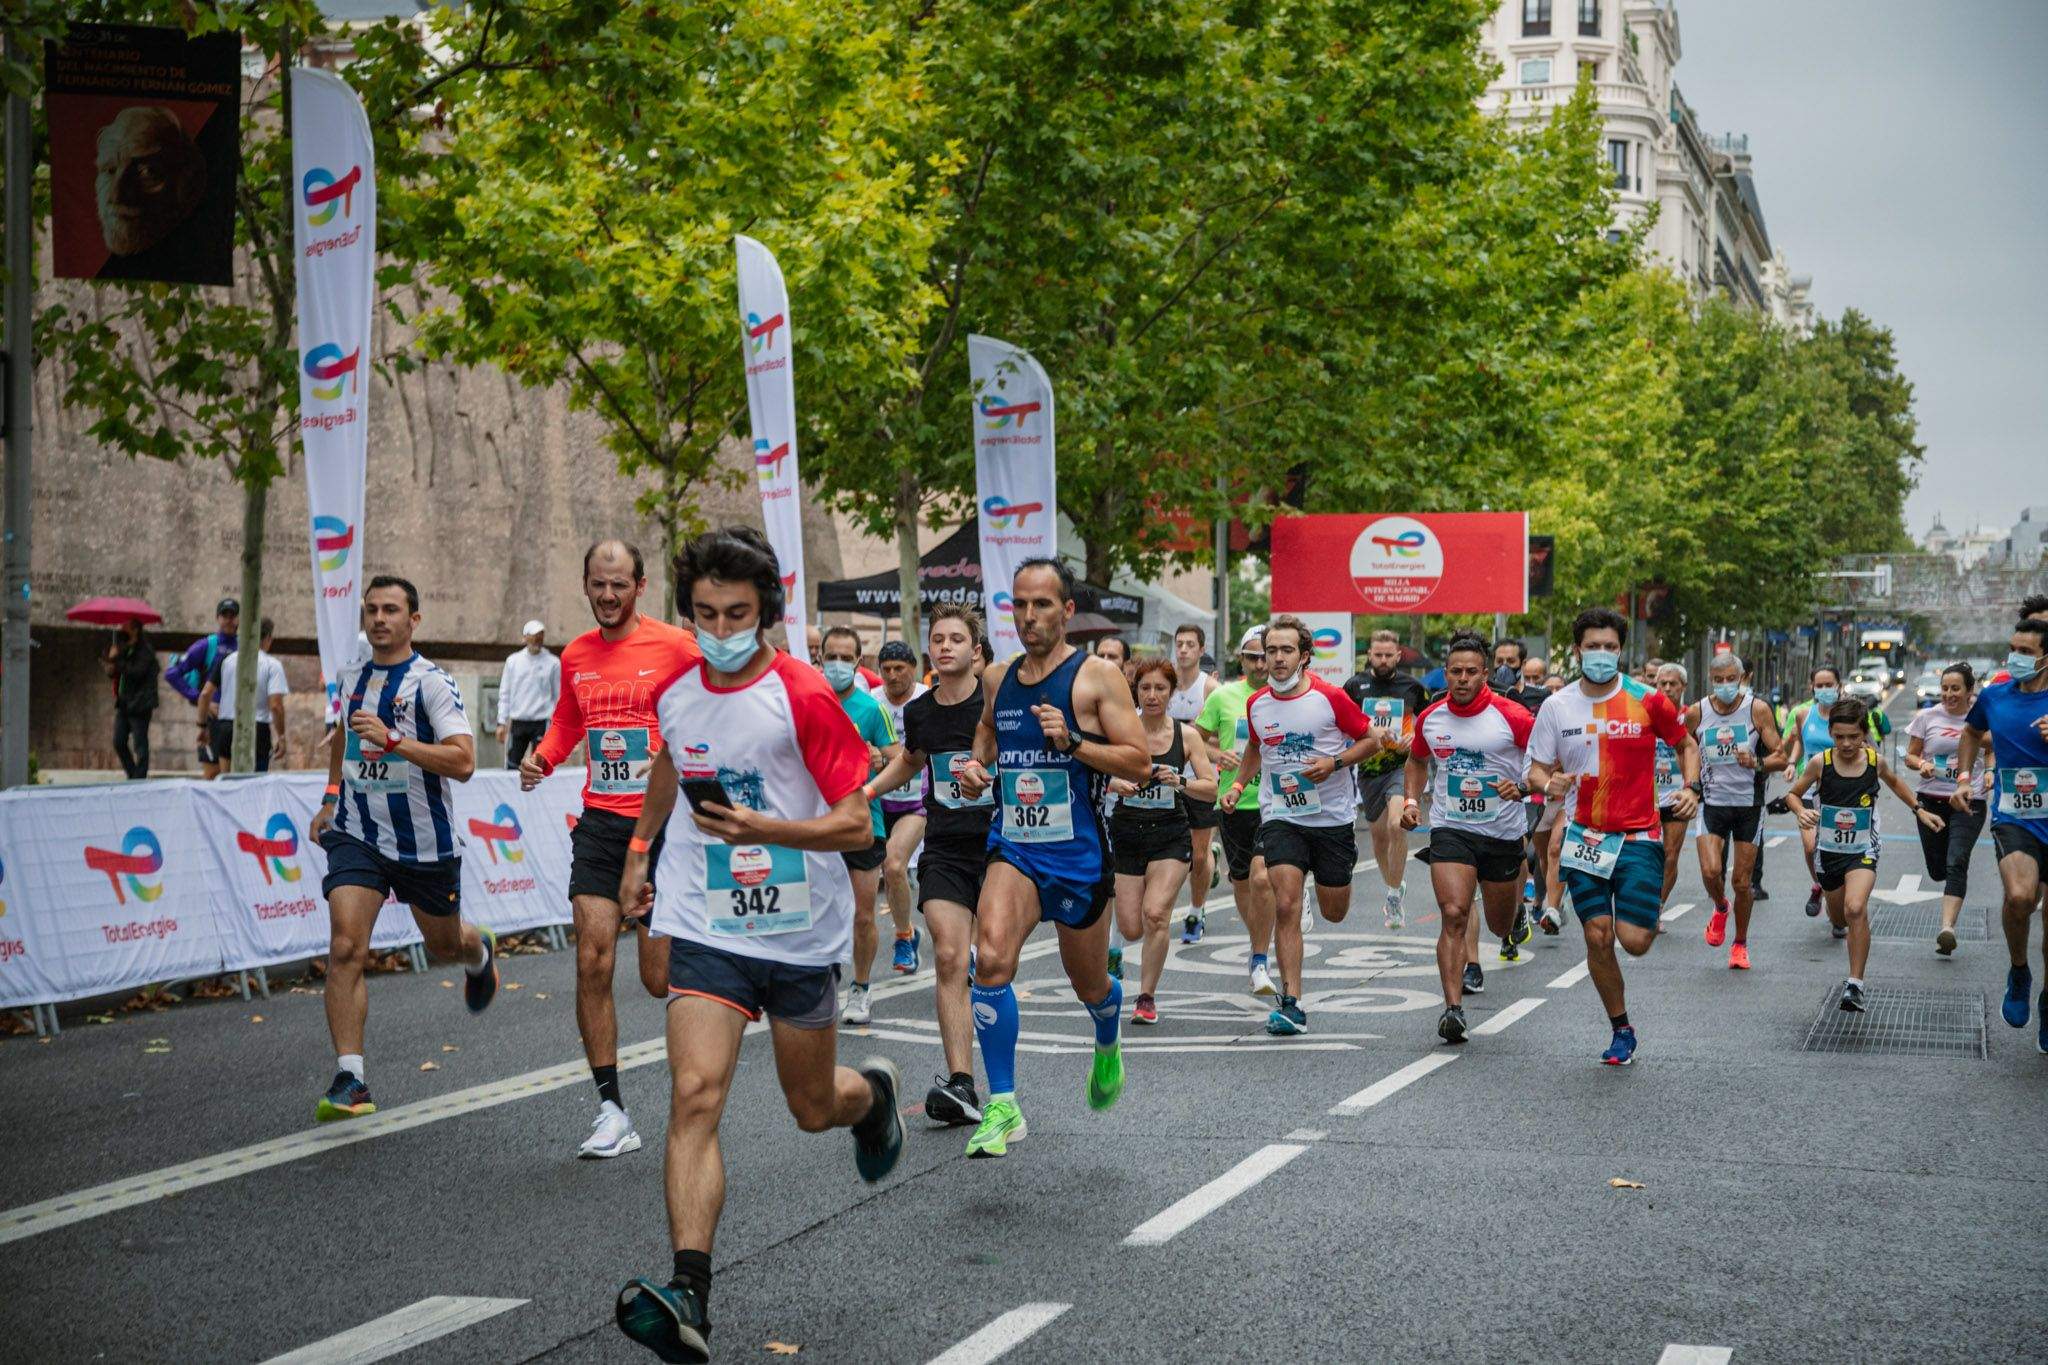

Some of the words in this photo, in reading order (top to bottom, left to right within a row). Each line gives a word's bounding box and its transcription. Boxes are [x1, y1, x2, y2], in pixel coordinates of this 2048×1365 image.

[169, 65, 187, 79] DE
[1606, 719, 1642, 735] Cris
[358, 761, 390, 781] 242
[601, 761, 631, 781] 313
[1283, 791, 1308, 809] 348
[1459, 798, 1486, 813] 349
[2013, 793, 2043, 809] 359
[1014, 804, 1050, 828] 362
[1834, 829, 1857, 844] 317
[1574, 844, 1602, 865] 355
[731, 885, 781, 917] 342
[102, 914, 178, 945] TotalEnergies
